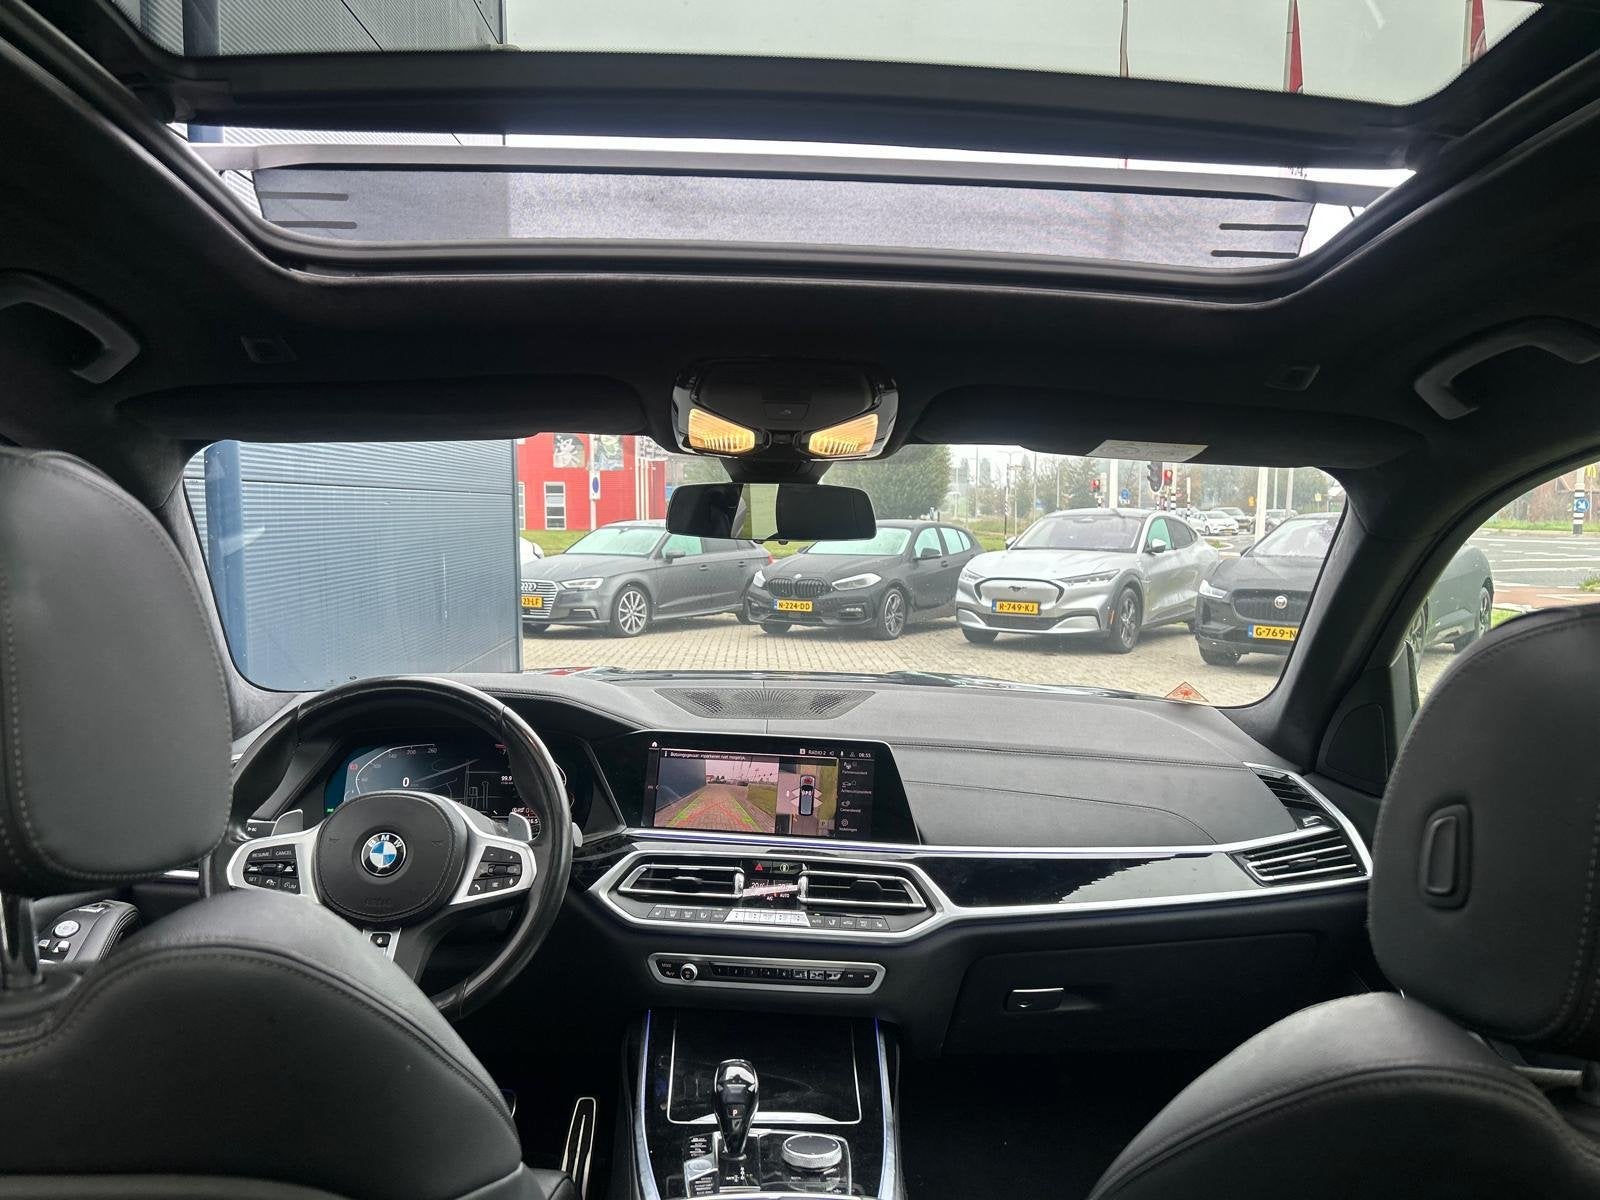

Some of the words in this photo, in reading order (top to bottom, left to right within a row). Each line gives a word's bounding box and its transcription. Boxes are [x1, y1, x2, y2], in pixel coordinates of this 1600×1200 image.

[778, 602, 811, 610] N-224-DD
[999, 603, 1035, 612] R-749-KJ
[402, 777, 410, 787] 0
[367, 834, 403, 848] BMW
